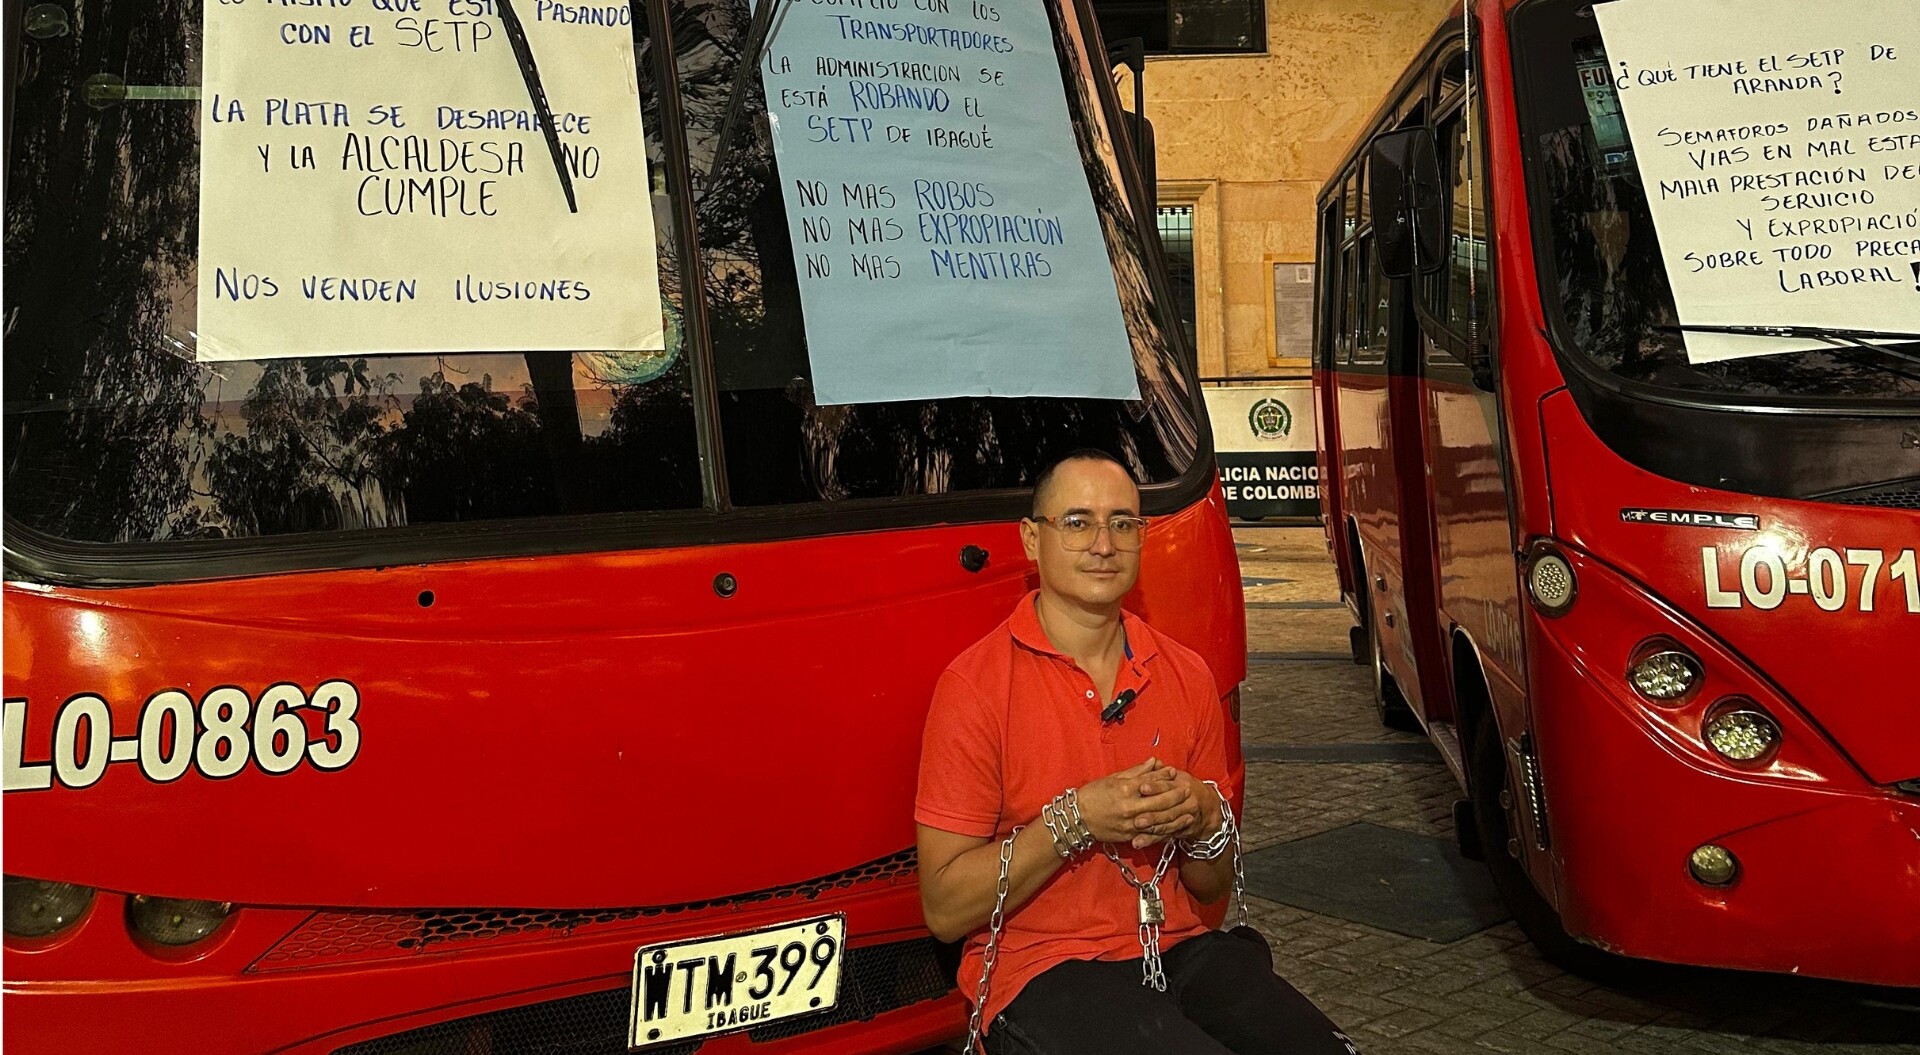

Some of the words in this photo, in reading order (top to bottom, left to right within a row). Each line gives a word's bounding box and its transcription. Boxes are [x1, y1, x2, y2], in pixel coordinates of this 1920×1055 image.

[536, 0, 631, 27] PASANDO
[972, 1, 1000, 22] LOS
[280, 22, 331, 45] CON
[349, 25, 374, 48] EL
[395, 17, 492, 53] SETP
[826, 14, 1014, 53] TRANSPORTADORES
[768, 48, 792, 75] LA
[816, 56, 960, 83] ADMINISTRACION
[978, 67, 1004, 87] SE
[1581, 66, 1610, 88] FU
[1683, 61, 1748, 80] TIENE
[1759, 55, 1782, 73] EL
[1786, 49, 1845, 69] SETP
[1870, 44, 1897, 61] DE
[211, 94, 246, 124] LA
[265, 98, 349, 128] PLATA
[367, 105, 406, 128] SE
[781, 85, 829, 109] ESTÁ
[849, 79, 950, 113] ROBANDO
[964, 97, 984, 118] EL
[807, 114, 873, 144] SETP
[886, 125, 912, 143] DE
[926, 124, 994, 149] IBAGUÉ
[1657, 123, 1790, 147] SEMAFOROS
[1807, 110, 1919, 132] DAÑADOS
[257, 143, 270, 172] Y
[290, 145, 315, 170] LA
[341, 132, 525, 176] ALCALDESA
[560, 142, 600, 179] NO
[1688, 146, 1750, 171] VIAS
[1763, 143, 1792, 161] EN
[1807, 139, 1856, 158] MAL
[1868, 134, 1920, 153] ESTA
[357, 174, 498, 218] CUMPLE
[796, 179, 829, 208] NO
[842, 182, 897, 210] MAS
[914, 178, 996, 211] ROBOS
[1731, 167, 1866, 194] PRESTACIÓN
[1760, 189, 1875, 212] SERVICIO
[801, 217, 831, 245] NO
[848, 216, 904, 245] MAS
[918, 207, 1065, 246] EXPROPIACIÓN
[1736, 218, 1753, 242] Y
[1768, 208, 1918, 239] EXPROPIACIÓ
[805, 252, 831, 279] NO
[852, 252, 901, 281] MAS
[930, 249, 1053, 281] MENTIRAS
[1684, 250, 1764, 274] SOBRE
[1772, 243, 1833, 264] TODO
[1856, 239, 1920, 258] PRECA
[215, 266, 279, 302] NOS
[301, 277, 417, 303] VENDEN
[455, 273, 592, 303] ILUSIONES
[1218, 467, 1261, 482] LICIA
[1265, 466, 1319, 481] NACIO
[1242, 485, 1321, 500] COLOMBI
[1701, 545, 1920, 613] LO-071
[706, 1001, 771, 1030] IBAGUE
